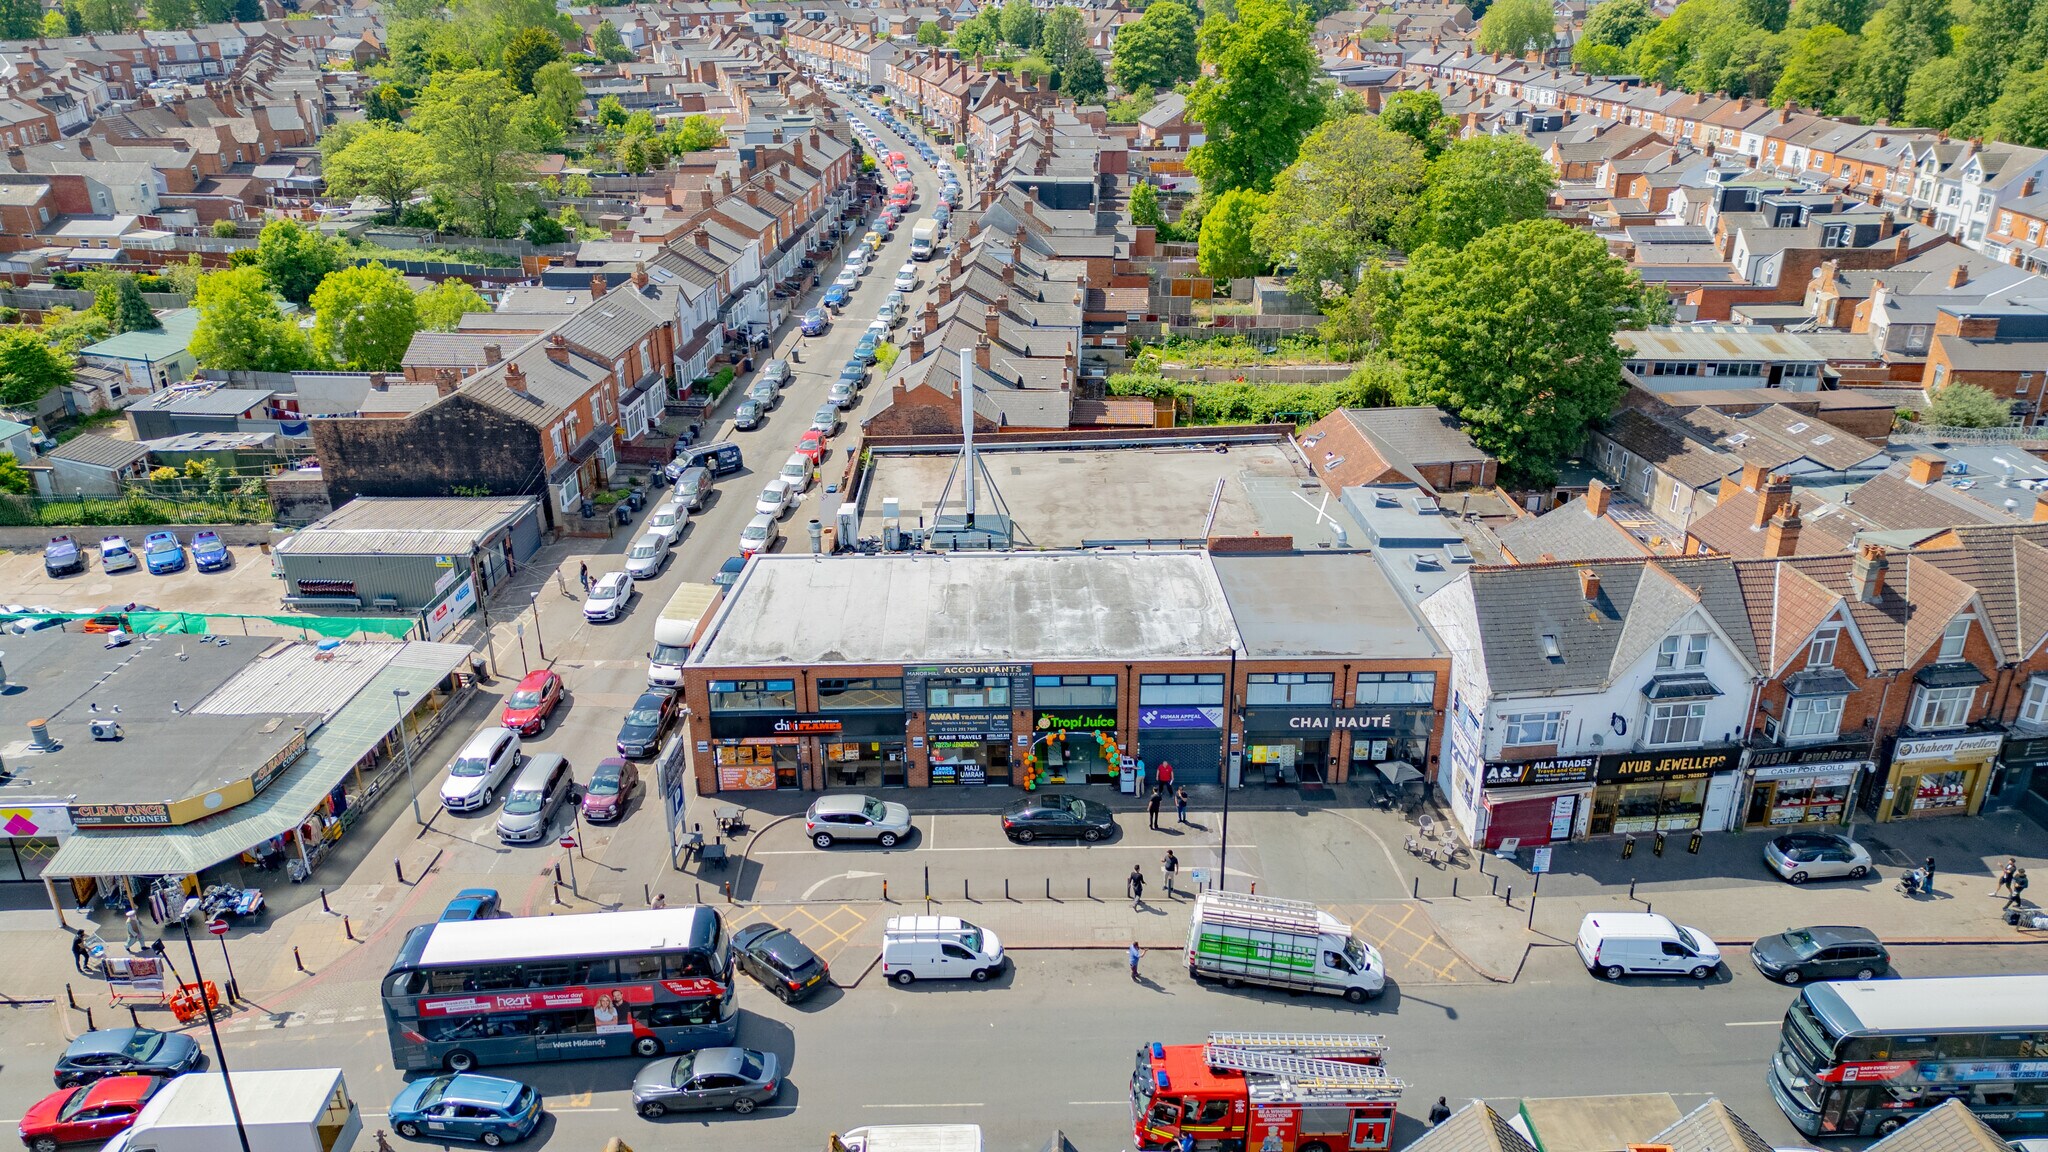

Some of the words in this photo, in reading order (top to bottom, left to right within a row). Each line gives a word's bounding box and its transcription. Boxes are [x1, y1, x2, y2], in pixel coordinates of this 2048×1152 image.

[943, 665, 1022, 674] ACCOUNTANTS
[799, 722, 842, 731] FLAMES
[1051, 714, 1083, 730] Tropi
[1084, 714, 1115, 727] Juice
[1289, 717, 1329, 728] CHAI
[1335, 714, 1391, 728] HAUTÉ
[1912, 742, 1953, 755] Shaheen
[1955, 737, 1999, 750] Jewellers
[258, 736, 305, 780] CLEARANCE
[282, 744, 306, 767] CORNER
[1753, 751, 1792, 765] DUBAI
[1798, 750, 1852, 762] Jewellers
[1533, 761, 1555, 769] AILA
[1556, 758, 1592, 767] TRADES
[1618, 760, 1652, 774] AYUB
[1770, 767, 1796, 775] CASH
[674, 787, 681, 812] P
[79, 805, 166, 817] CLEARANCE
[124, 815, 168, 823] CORNER
[496, 994, 531, 1007] heart
[573, 1038, 606, 1047] Midlands
